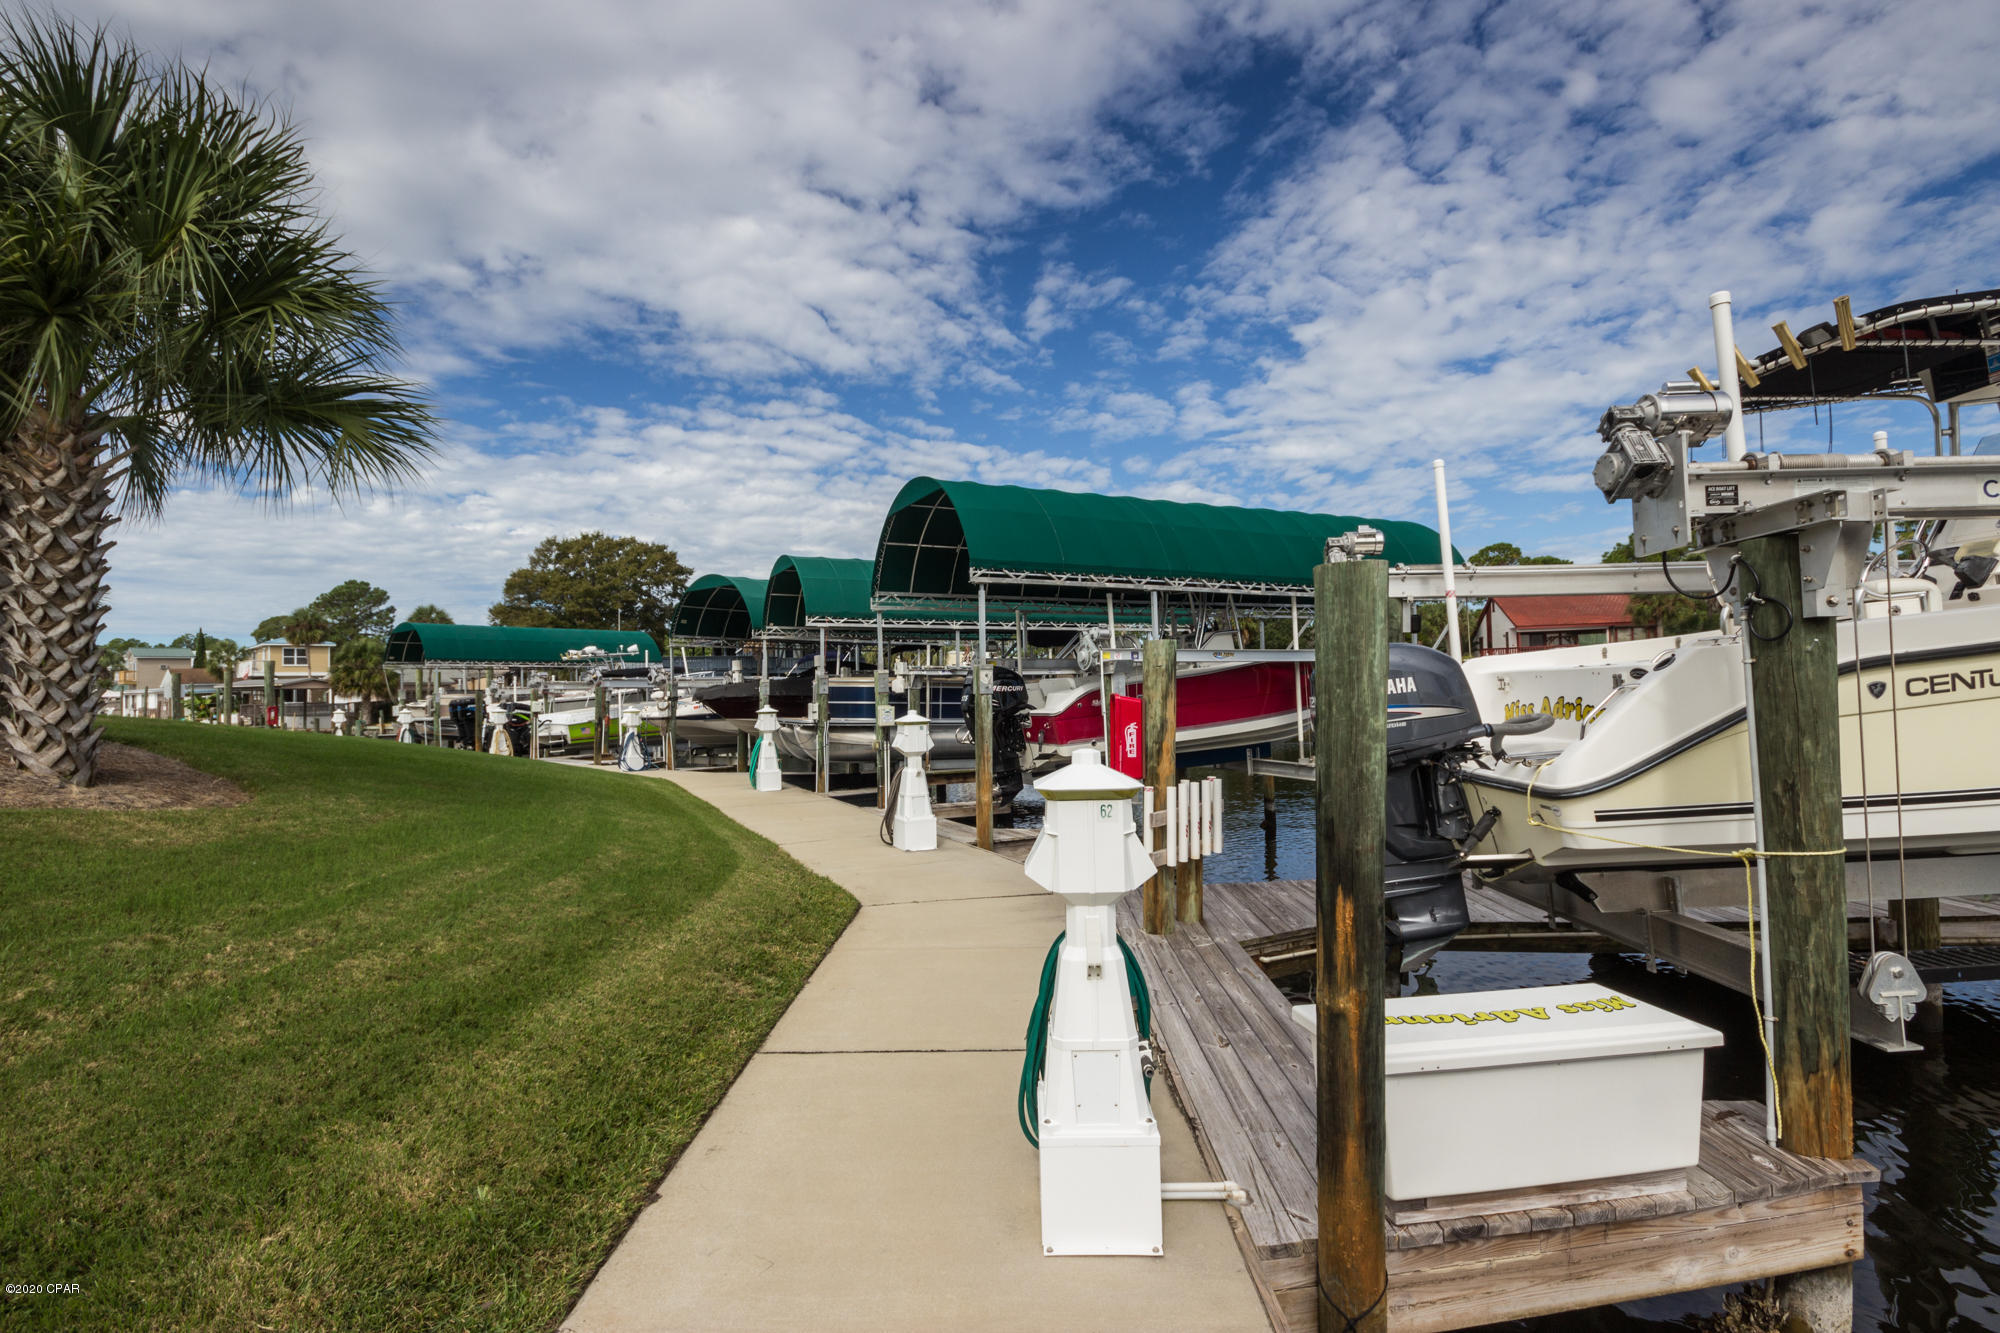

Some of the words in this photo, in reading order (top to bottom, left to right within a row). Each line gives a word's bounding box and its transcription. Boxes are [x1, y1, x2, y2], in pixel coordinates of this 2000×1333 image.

[1128, 731, 1136, 756] FIRE
[1100, 804, 1113, 818] 62
[1556, 995, 1637, 1013] Miss
